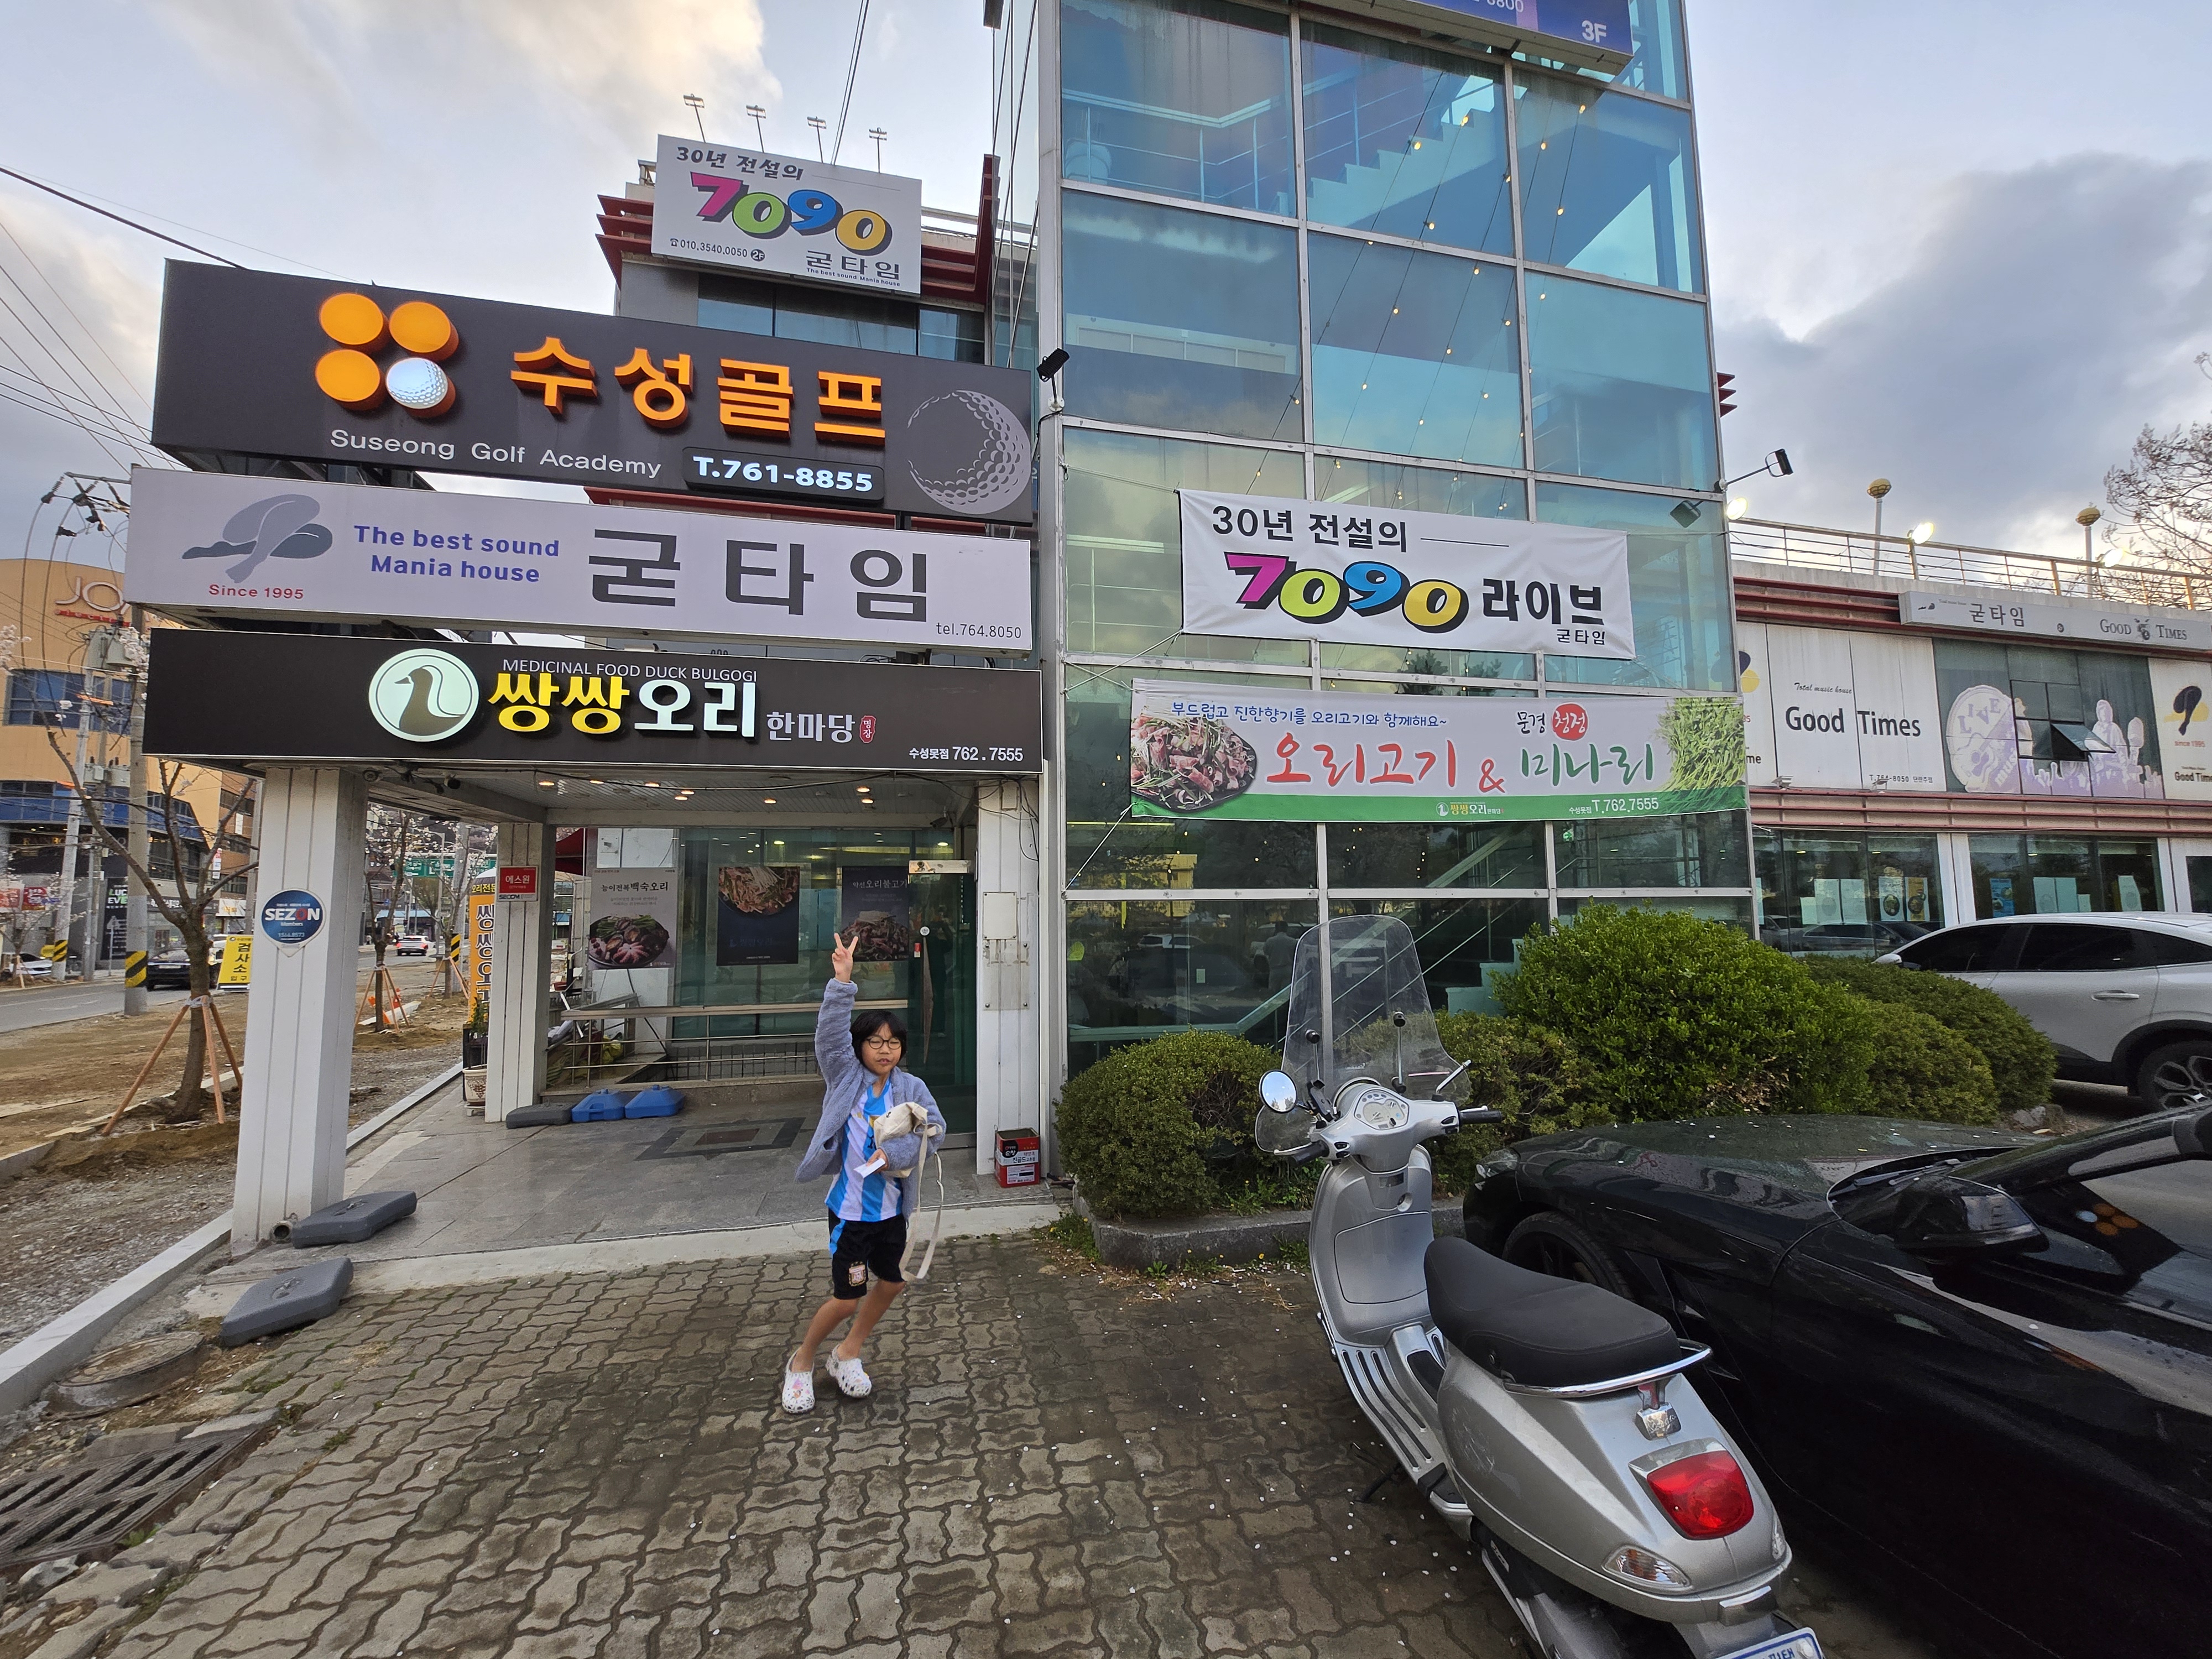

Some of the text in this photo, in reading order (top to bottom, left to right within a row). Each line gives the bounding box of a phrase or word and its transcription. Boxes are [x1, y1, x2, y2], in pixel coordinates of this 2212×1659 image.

[1582, 20, 1606, 43] 3F
[677, 147, 804, 181] 30년 전설의
[691, 172, 893, 256] 7090
[680, 239, 747, 258] 010.3540.0050
[806, 251, 899, 280] 굳타임
[881, 279, 900, 287] house
[510, 336, 885, 445] 수성골프
[331, 429, 661, 479] Suseong Golf Academy
[692, 456, 872, 492] T.761-8855
[354, 525, 560, 556] The best sound
[1212, 506, 1407, 552] 30년 전설의
[371, 555, 540, 582] Mania house
[588, 529, 927, 622] 굳타임
[208, 583, 304, 600] Since 1995
[1223, 551, 1605, 634] 7090 라이브
[1969, 603, 2024, 627] 굳타임
[936, 622, 1022, 639] tel.764.8050
[1557, 628, 1606, 645] 굳타임
[503, 659, 757, 682] MEDICINAL FOOD DUCK BULGOGI
[1794, 682, 1813, 692] Total
[1835, 685, 1853, 695] house
[488, 672, 855, 744] 쌍쌍오리 한마당
[1171, 702, 1447, 728] 부드럽고 진한향기를 오리고기와 함께해요~
[1517, 711, 1586, 734] 문경 청정
[1785, 706, 1921, 737] Good Times
[909, 748, 949, 760] 수성못점
[1267, 732, 1654, 793] 오리고기 & 미나리
[2174, 771, 2194, 781] Good
[1592, 797, 1659, 814] T.762.7555
[505, 875, 530, 884] 에스원
[265, 908, 320, 921] SEZON
